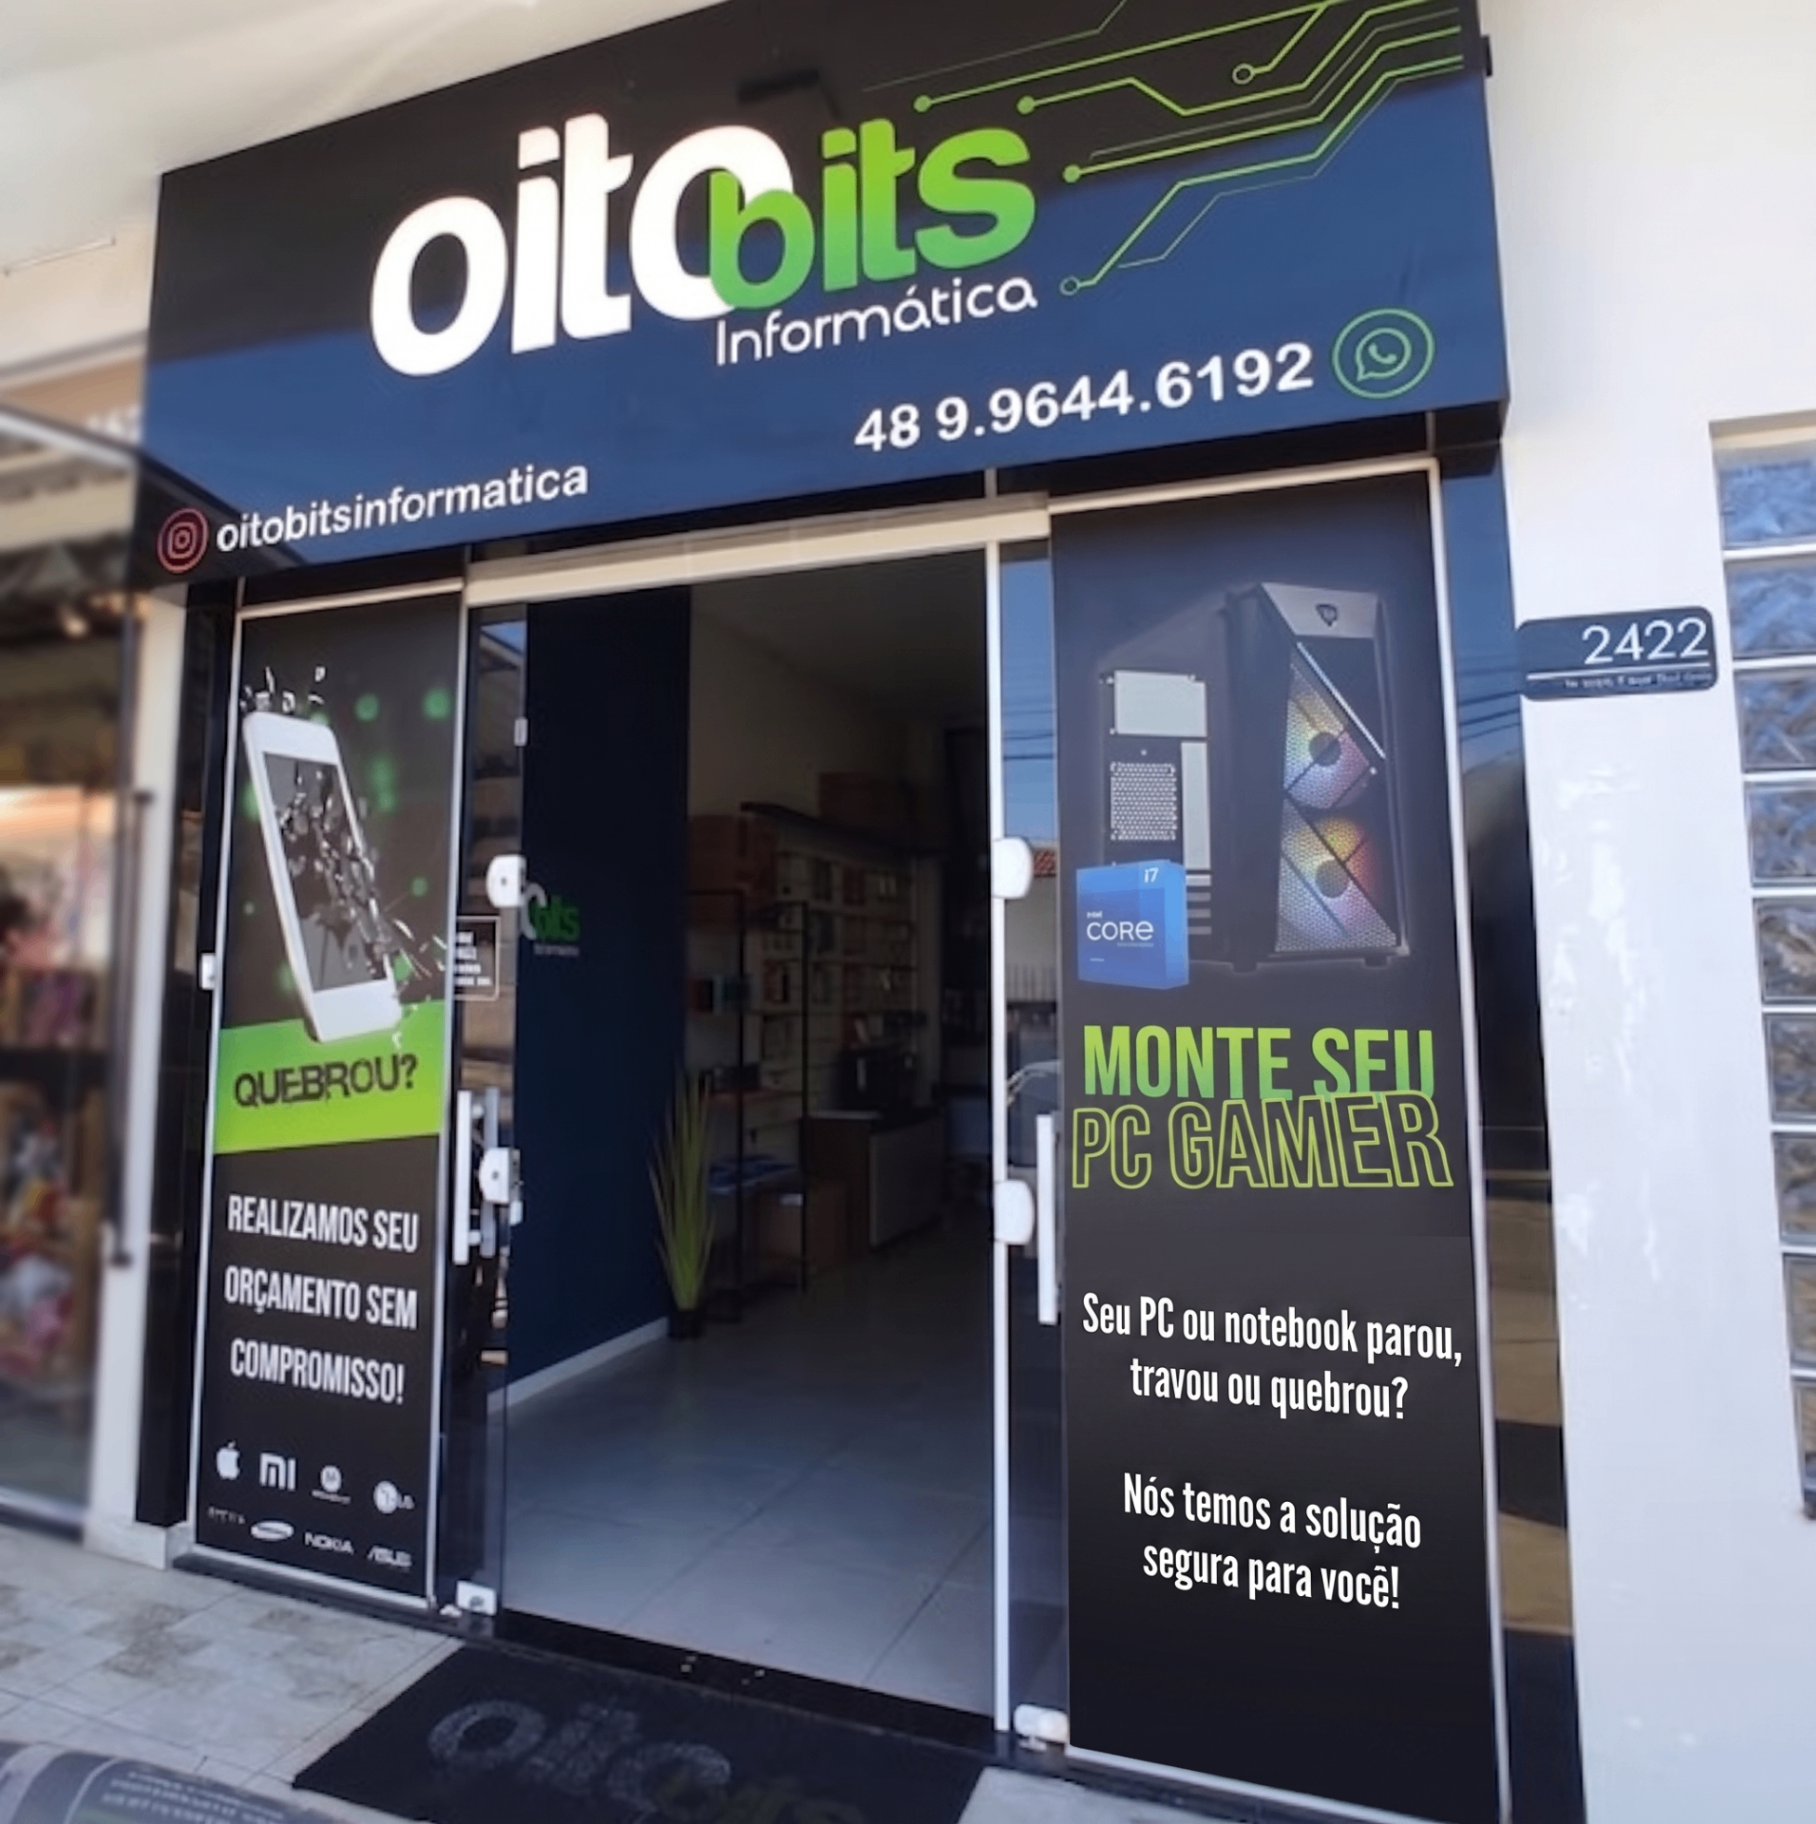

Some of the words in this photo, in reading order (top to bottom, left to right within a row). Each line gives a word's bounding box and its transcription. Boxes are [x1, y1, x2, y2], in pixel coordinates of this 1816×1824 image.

[709, 118, 1036, 310] bits
[716, 276, 1039, 366] Informática
[853, 405, 921, 452] 48
[936, 341, 1314, 442] 9.9644.6192
[216, 464, 589, 553] oitobitsinformatica
[1582, 616, 1709, 665] 2422
[1144, 867, 1159, 883] i7
[234, 1053, 419, 1108] QUEBROU?
[1083, 1024, 1293, 1100] MONTE
[1312, 1028, 1435, 1102] SEU
[1071, 1104, 1152, 1189] PC
[1168, 1090, 1455, 1189] GAMER
[228, 1194, 368, 1248] REALIZAMOS
[373, 1208, 419, 1254] SEU
[224, 1264, 360, 1321] ORÇAMENTO
[366, 1284, 418, 1331] SEM
[1082, 1292, 1132, 1336] Seu
[1139, 1296, 1174, 1339] PC
[1183, 1308, 1216, 1343] ou
[1224, 1304, 1359, 1354] notebook
[1366, 1320, 1463, 1368] parou,
[230, 1337, 405, 1405] COMPROMISSO!
[1130, 1357, 1219, 1404] travou
[1228, 1373, 1261, 1406] ou
[1271, 1370, 1408, 1420] quebrou?
[1123, 1472, 1175, 1519] Nós
[1183, 1482, 1272, 1531] temos
[1280, 1500, 1296, 1533] a
[1305, 1497, 1422, 1554] solução
[1143, 1544, 1239, 1591] segura
[1249, 1557, 1313, 1600] para
[1321, 1562, 1400, 1610] você!
